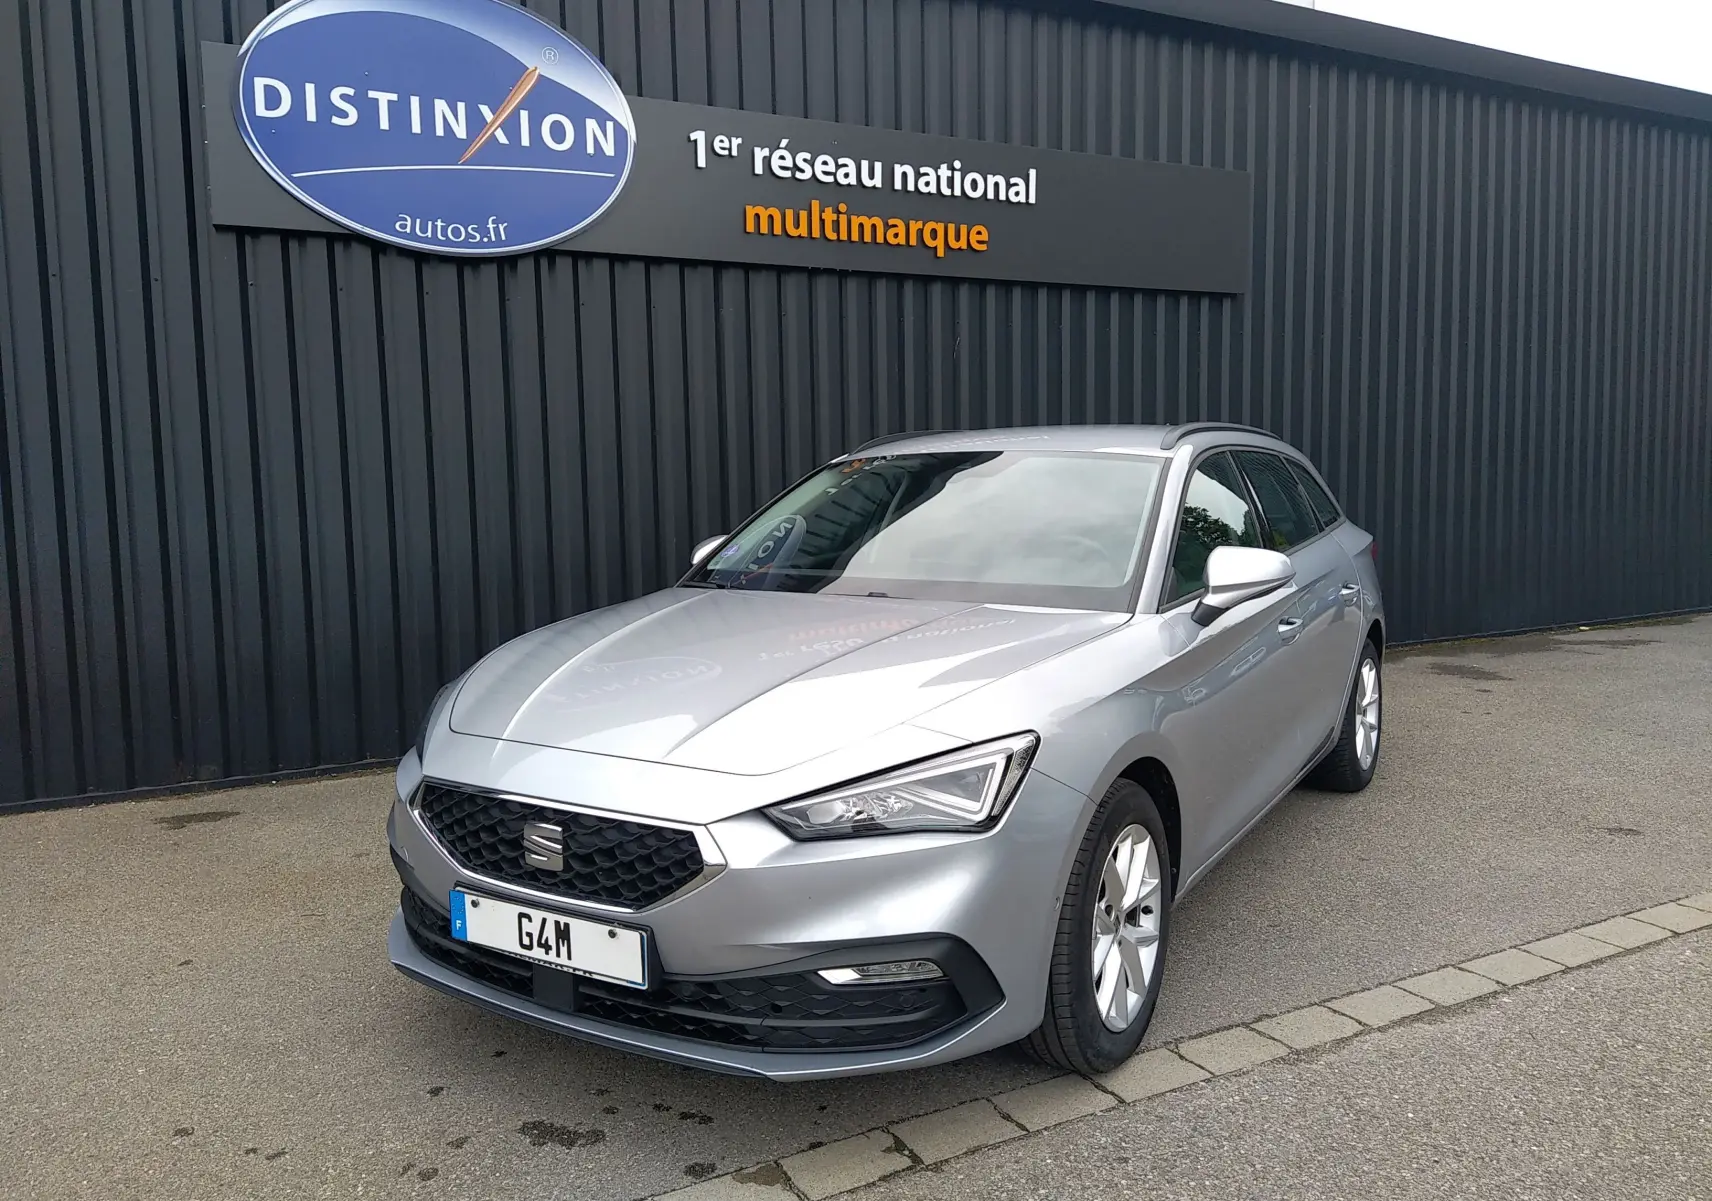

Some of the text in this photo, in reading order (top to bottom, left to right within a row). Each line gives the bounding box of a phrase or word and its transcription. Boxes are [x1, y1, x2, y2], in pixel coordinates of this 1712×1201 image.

[253, 76, 615, 156] DISTINXION
[753, 138, 883, 189] réseau
[893, 160, 1037, 204] national
[394, 214, 509, 243] autos.fr
[744, 200, 989, 258] multimarque
[455, 919, 462, 931] F
[517, 912, 572, 961] G4M
